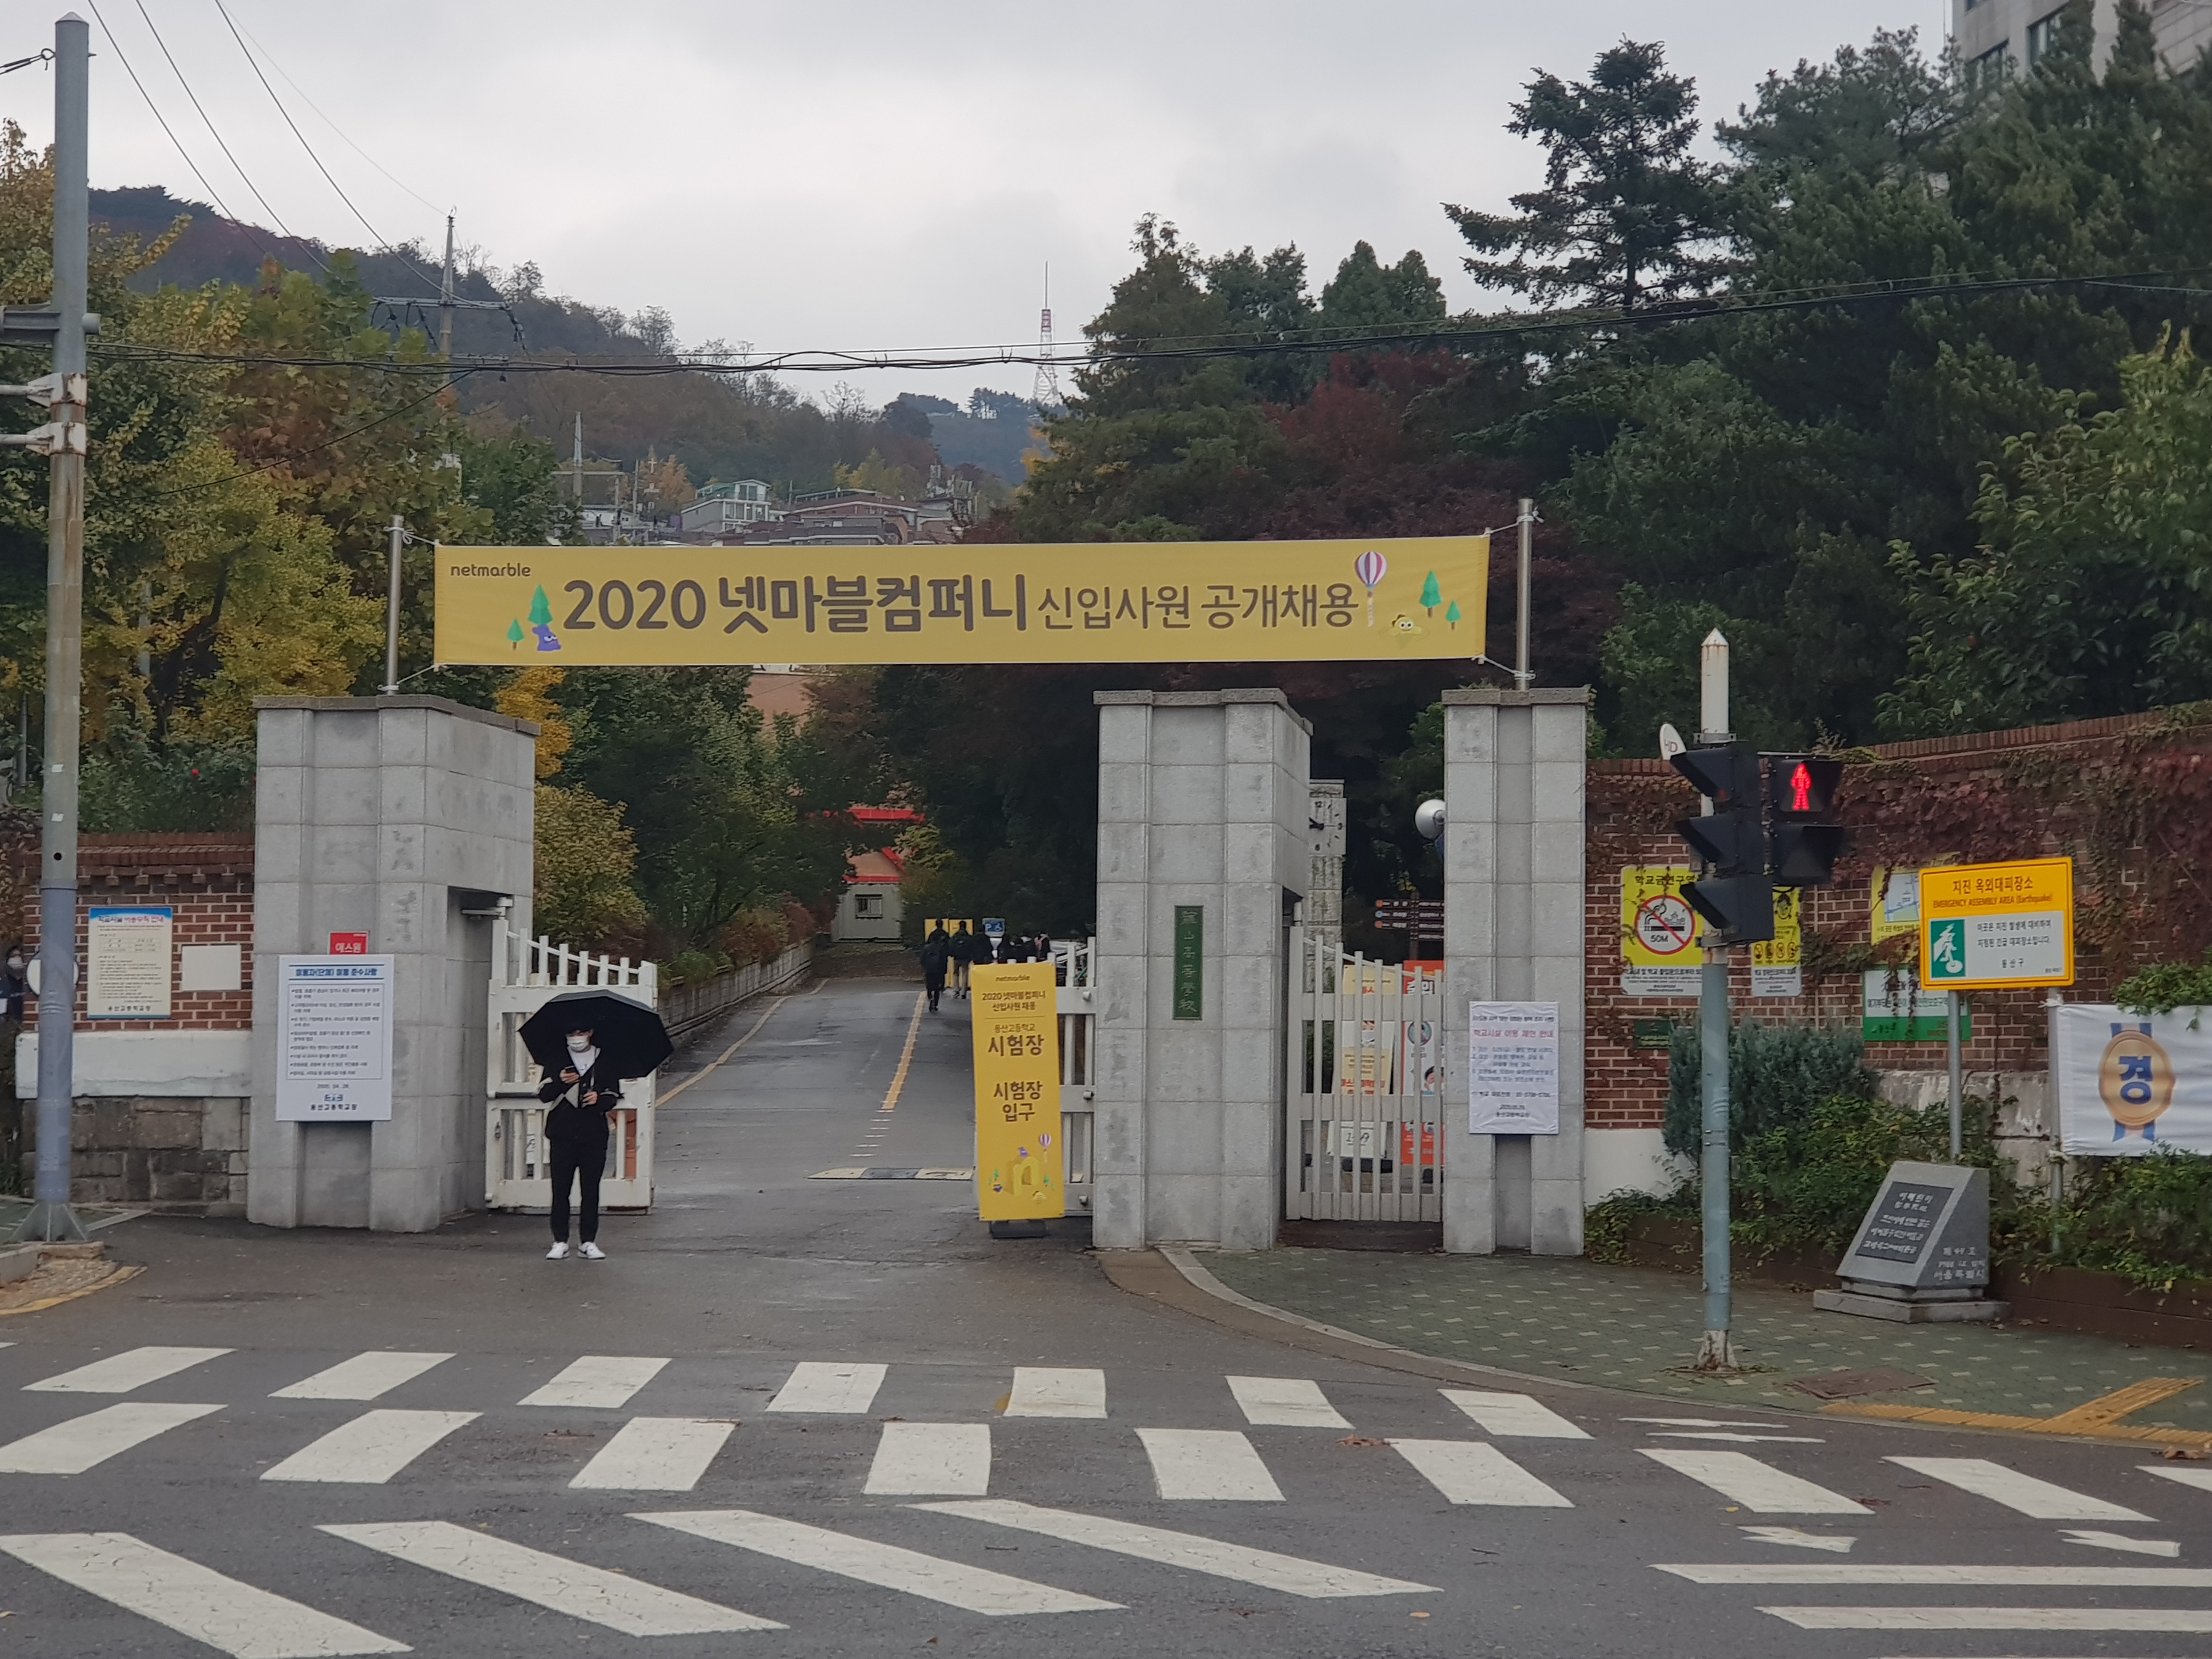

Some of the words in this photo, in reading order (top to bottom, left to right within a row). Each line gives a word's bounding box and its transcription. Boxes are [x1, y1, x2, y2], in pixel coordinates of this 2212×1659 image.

[450, 563, 531, 577] netmarble
[563, 579, 707, 630] 2020
[718, 574, 1026, 634] 넷마블컴퍼니
[1037, 585, 1190, 630] 신입사원
[1201, 582, 1359, 629] 공개채용
[1953, 879, 1971, 894] 지진
[1975, 876, 2034, 893] 옥외대피장소
[1933, 899, 1966, 909] EMERGENCY
[1999, 896, 2015, 904] AREA
[1650, 934, 1668, 943] 50M
[335, 942, 362, 953] 에스원
[995, 974, 1030, 983] netmarble
[981, 992, 1002, 1001] 2020
[992, 1002, 1021, 1012] 신입사원
[1022, 1002, 1036, 1011] 채용
[988, 1034, 1045, 1057] 시험장
[993, 1080, 1043, 1102] 시험장
[1001, 1102, 1036, 1123] 입구
